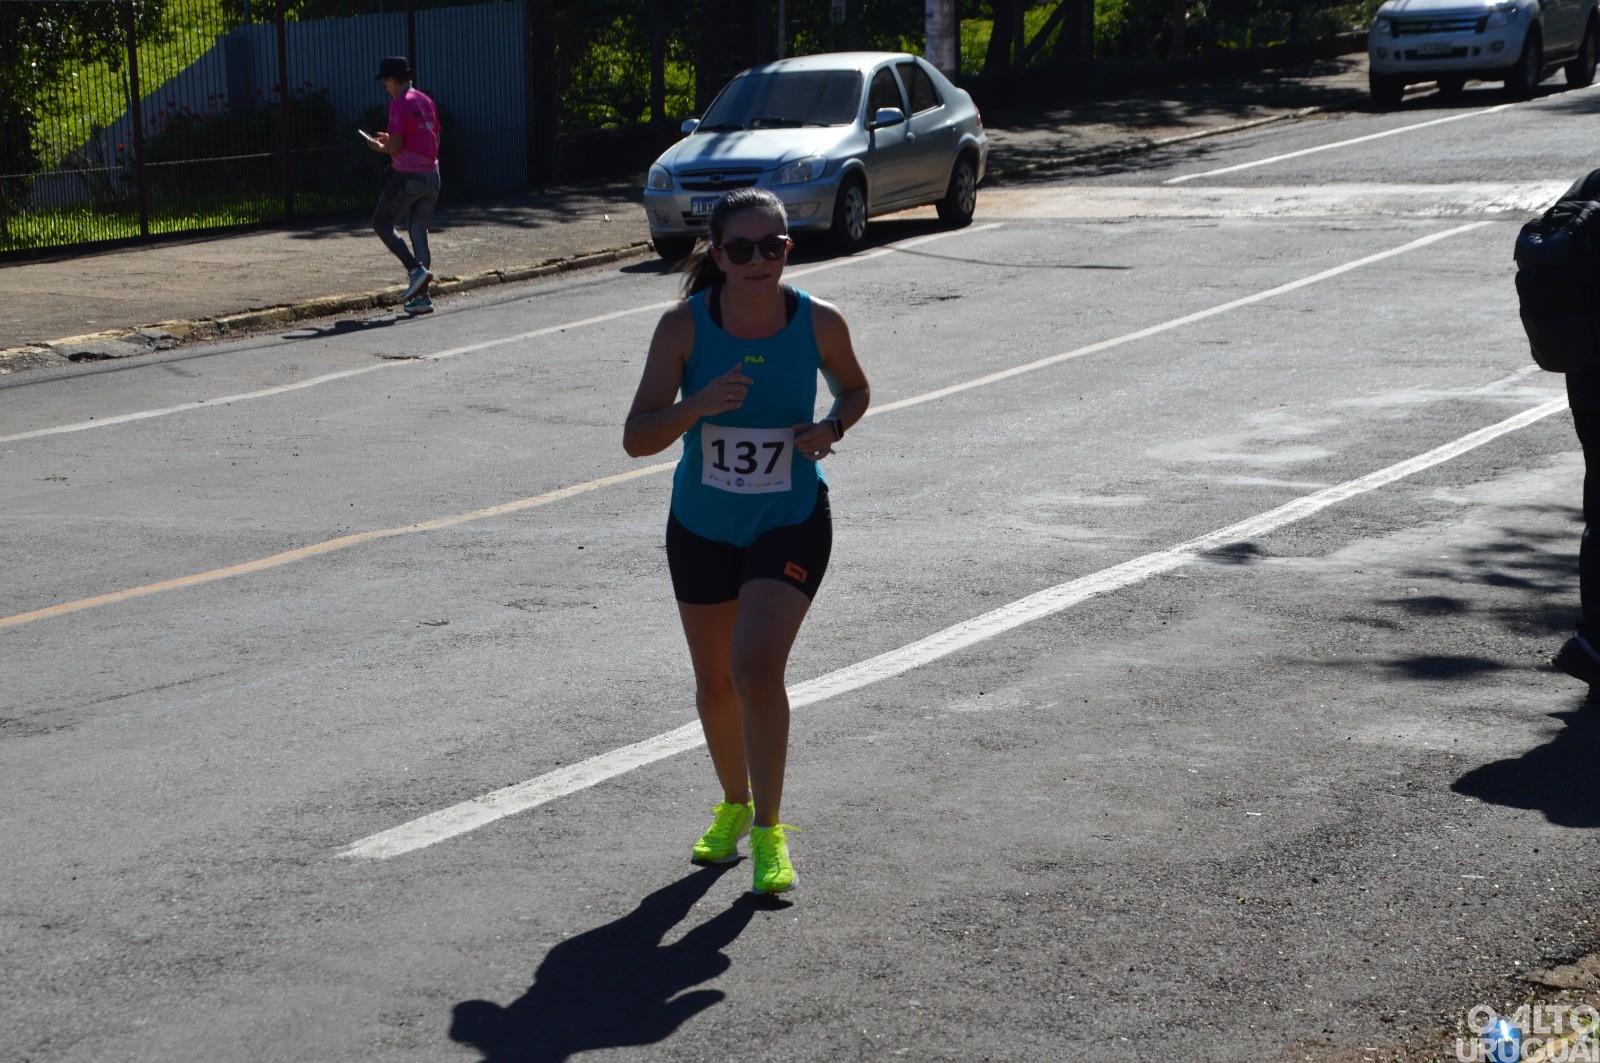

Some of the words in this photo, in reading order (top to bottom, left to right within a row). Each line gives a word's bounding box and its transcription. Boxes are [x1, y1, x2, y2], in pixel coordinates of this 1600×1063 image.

[696, 203, 713, 213] IRX
[744, 355, 765, 364] FILA
[711, 439, 785, 475] 137
